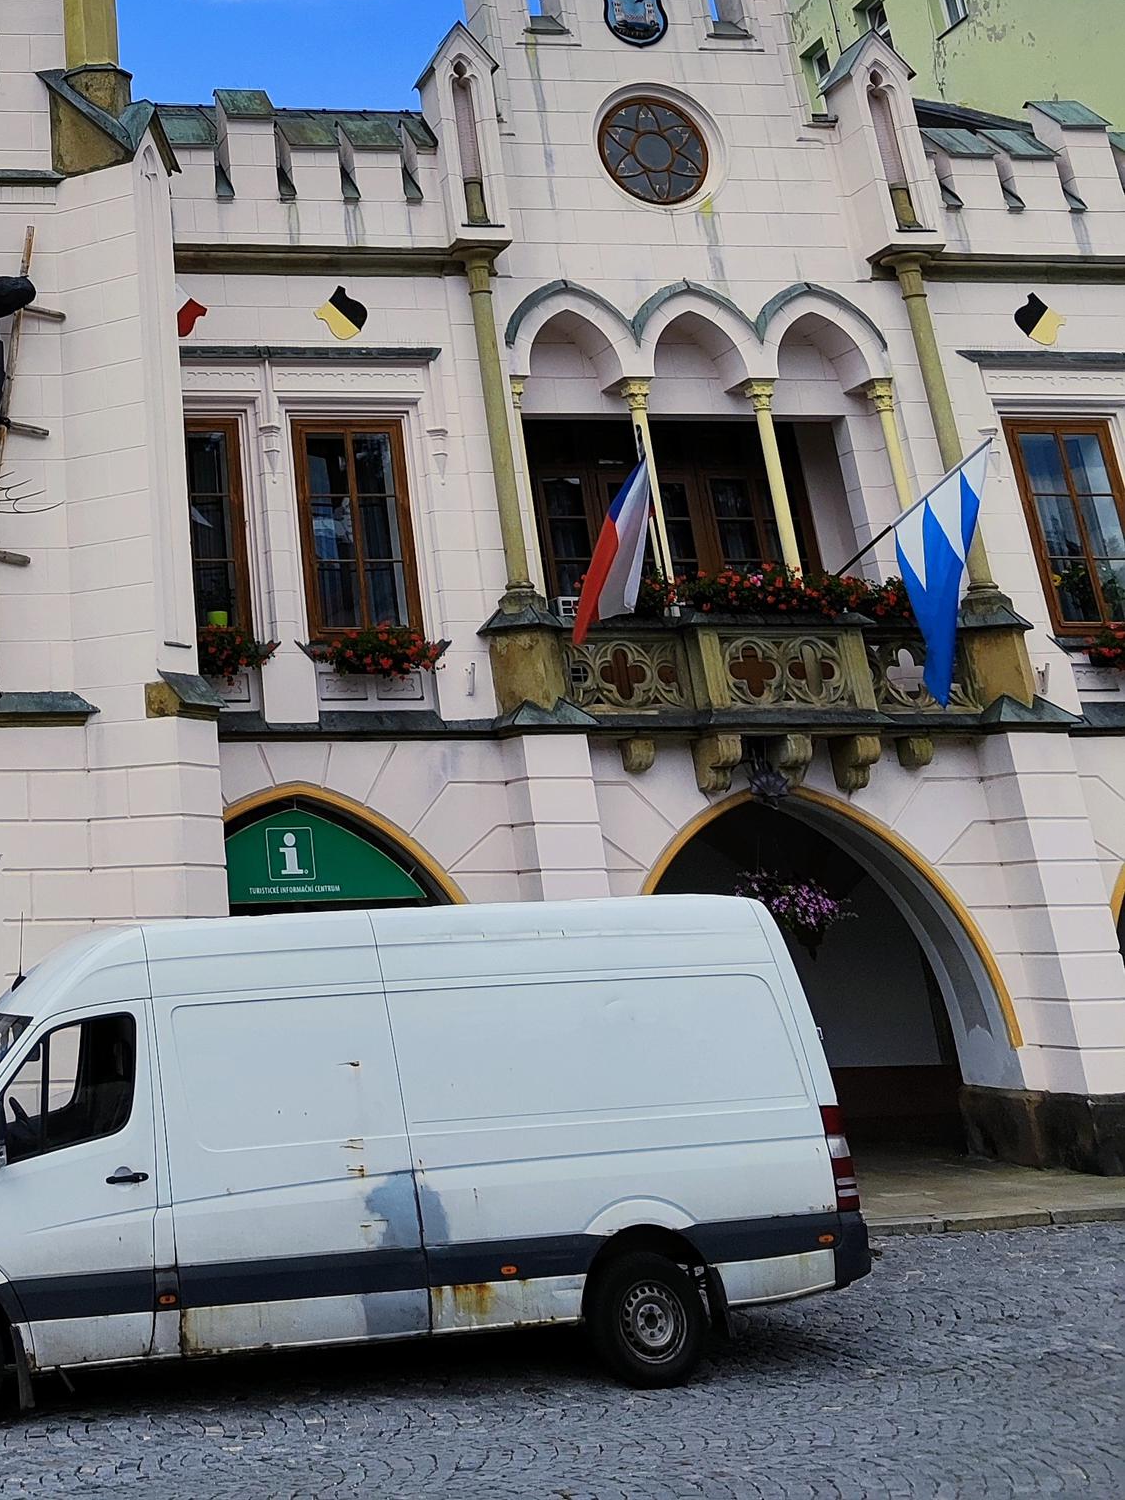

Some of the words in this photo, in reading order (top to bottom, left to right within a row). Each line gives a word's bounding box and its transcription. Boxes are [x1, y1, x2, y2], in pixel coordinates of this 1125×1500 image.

[249, 886, 280, 895] TURISTICKÉ
[279, 884, 314, 894] INFORMAČNÍ
[314, 884, 341, 893] CENTRUM
